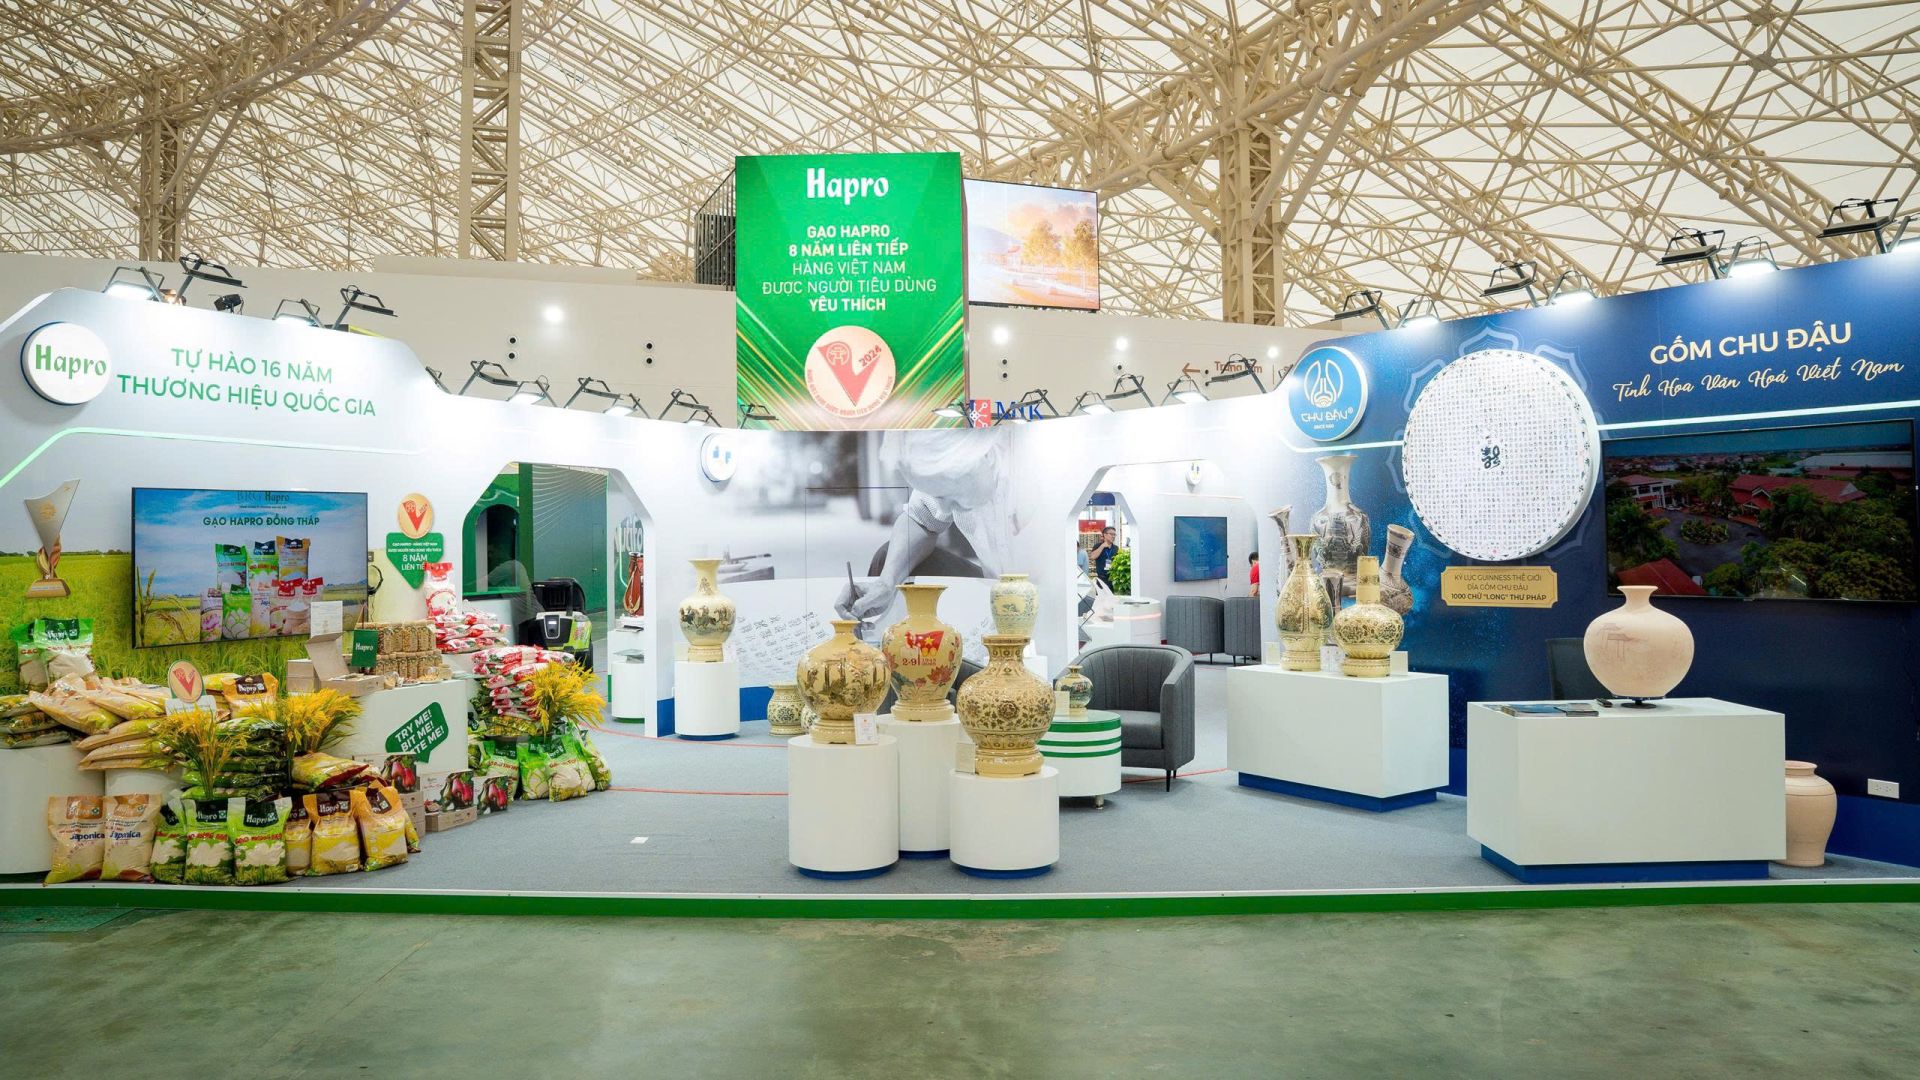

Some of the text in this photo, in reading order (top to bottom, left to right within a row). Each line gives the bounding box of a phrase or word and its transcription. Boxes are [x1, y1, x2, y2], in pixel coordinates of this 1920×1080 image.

[806, 168, 889, 205] Hapro
[807, 225, 890, 241] GẠO HAPRO
[789, 237, 909, 257] 8 NĂM LIÊN TIẾP
[793, 257, 905, 277] HÀNG VIỆT NAM
[762, 276, 937, 296] ĐƯỢC NGƯỜI TIÊU DÙNG
[809, 295, 886, 311] YÊU THÍCH
[1650, 320, 1851, 364] GỐM CHU ĐẬU
[35, 344, 107, 379] Hapro
[171, 347, 332, 383] TỰ HÀO 16 NĂM
[859, 345, 882, 366] 2024
[1612, 356, 1904, 402] Tinh Hoa Văn Hoá Việt Nam
[117, 374, 376, 416] THƯƠNG HIỆU QUỐC GIA
[203, 517, 227, 528] GẠO
[230, 517, 263, 526] HAPRO
[296, 515, 320, 526] THÁP
[403, 553, 428, 562] 8 NĂM
[1526, 592, 1547, 601] PHÁP
[355, 642, 374, 652] Hapro
[238, 683, 257, 695] Hapro
[395, 709, 432, 743] TRY ME!
[400, 720, 434, 752] BIT ME!
[427, 725, 445, 744] ME!
